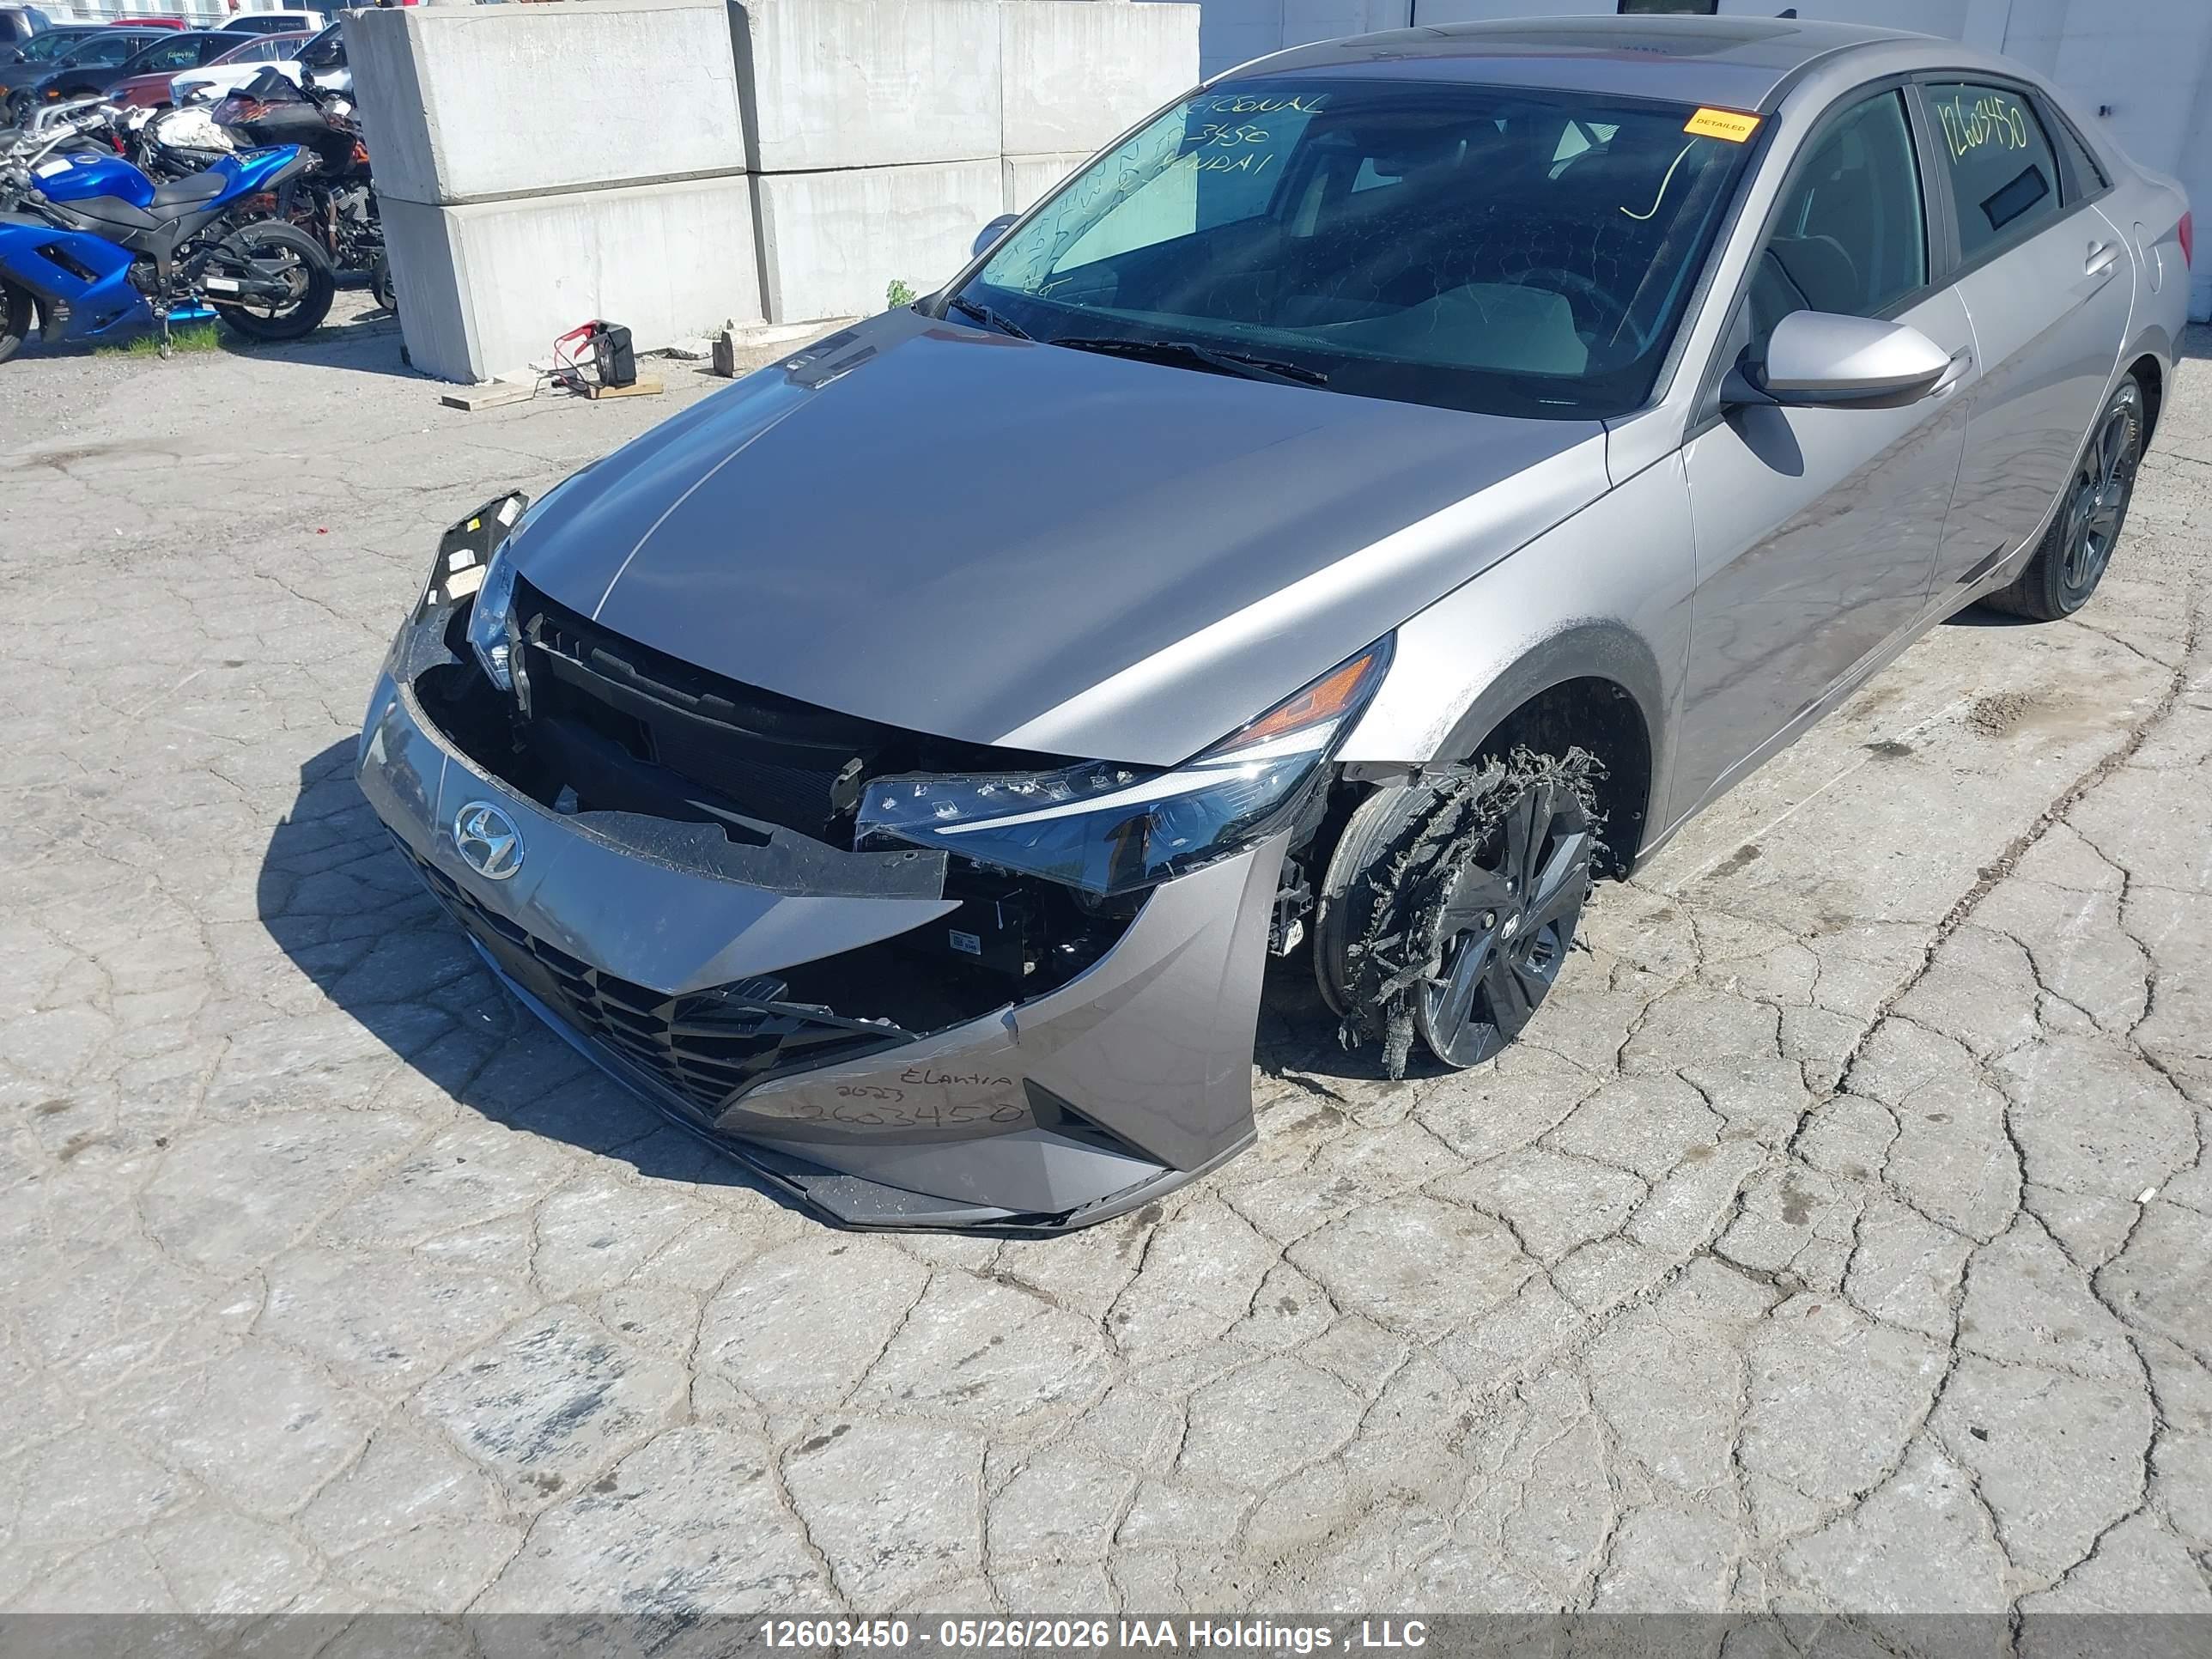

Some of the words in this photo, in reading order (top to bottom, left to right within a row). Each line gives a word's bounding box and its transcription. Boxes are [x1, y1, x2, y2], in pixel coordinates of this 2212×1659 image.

[1695, 117, 1747, 133] DETAILED
[1936, 94, 2027, 166] 12603450
[836, 1085, 905, 1103] 2023
